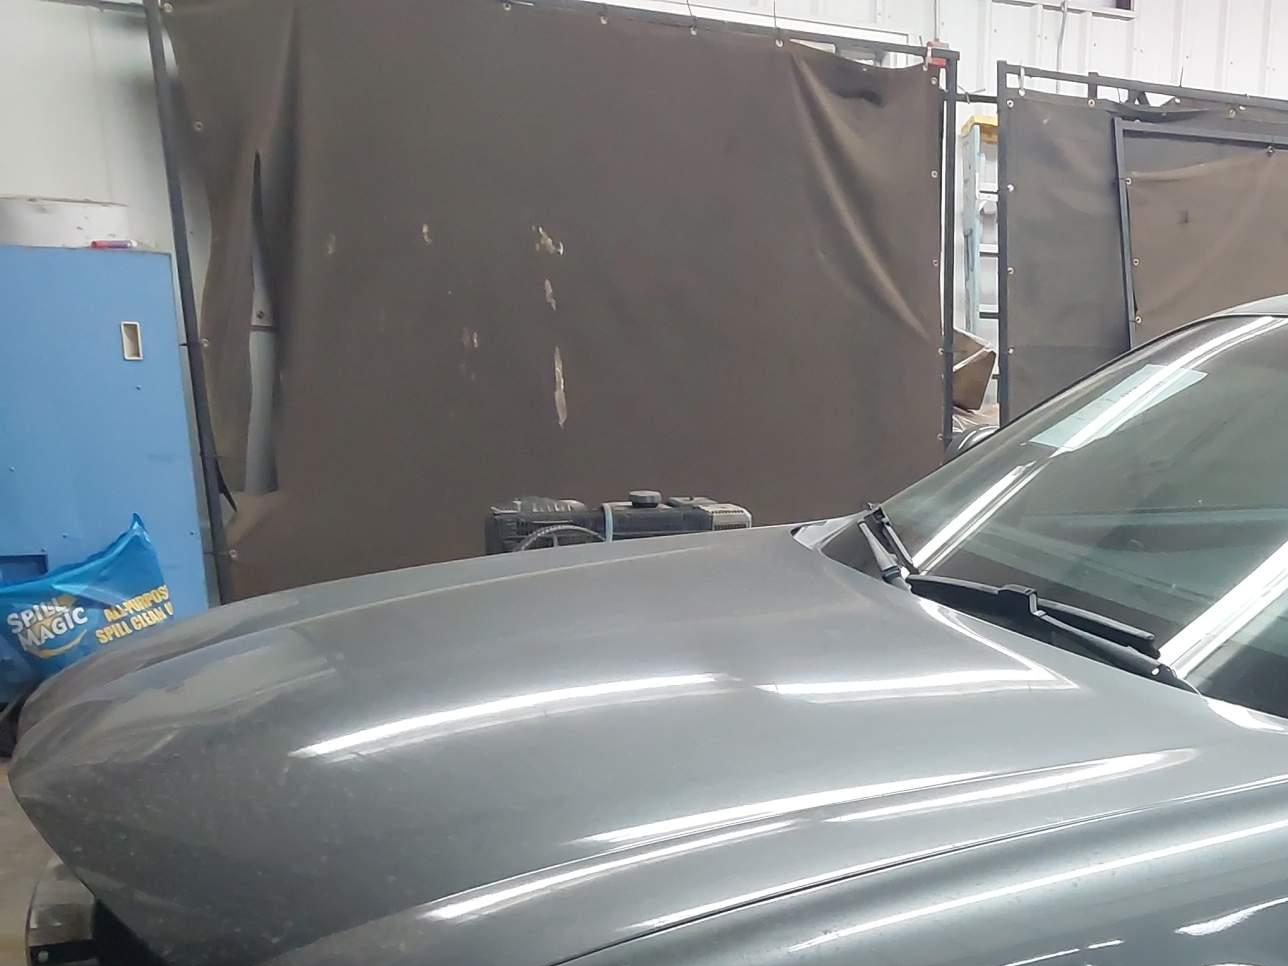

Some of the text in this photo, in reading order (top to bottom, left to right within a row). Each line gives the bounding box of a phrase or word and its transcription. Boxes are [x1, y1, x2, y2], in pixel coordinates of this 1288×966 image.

[7, 598, 69, 633] SPILL
[104, 585, 169, 622] ALL-PURPOS
[18, 607, 88, 651] MAGIC
[96, 621, 133, 644] SPILL
[130, 607, 167, 630] CLEAN
